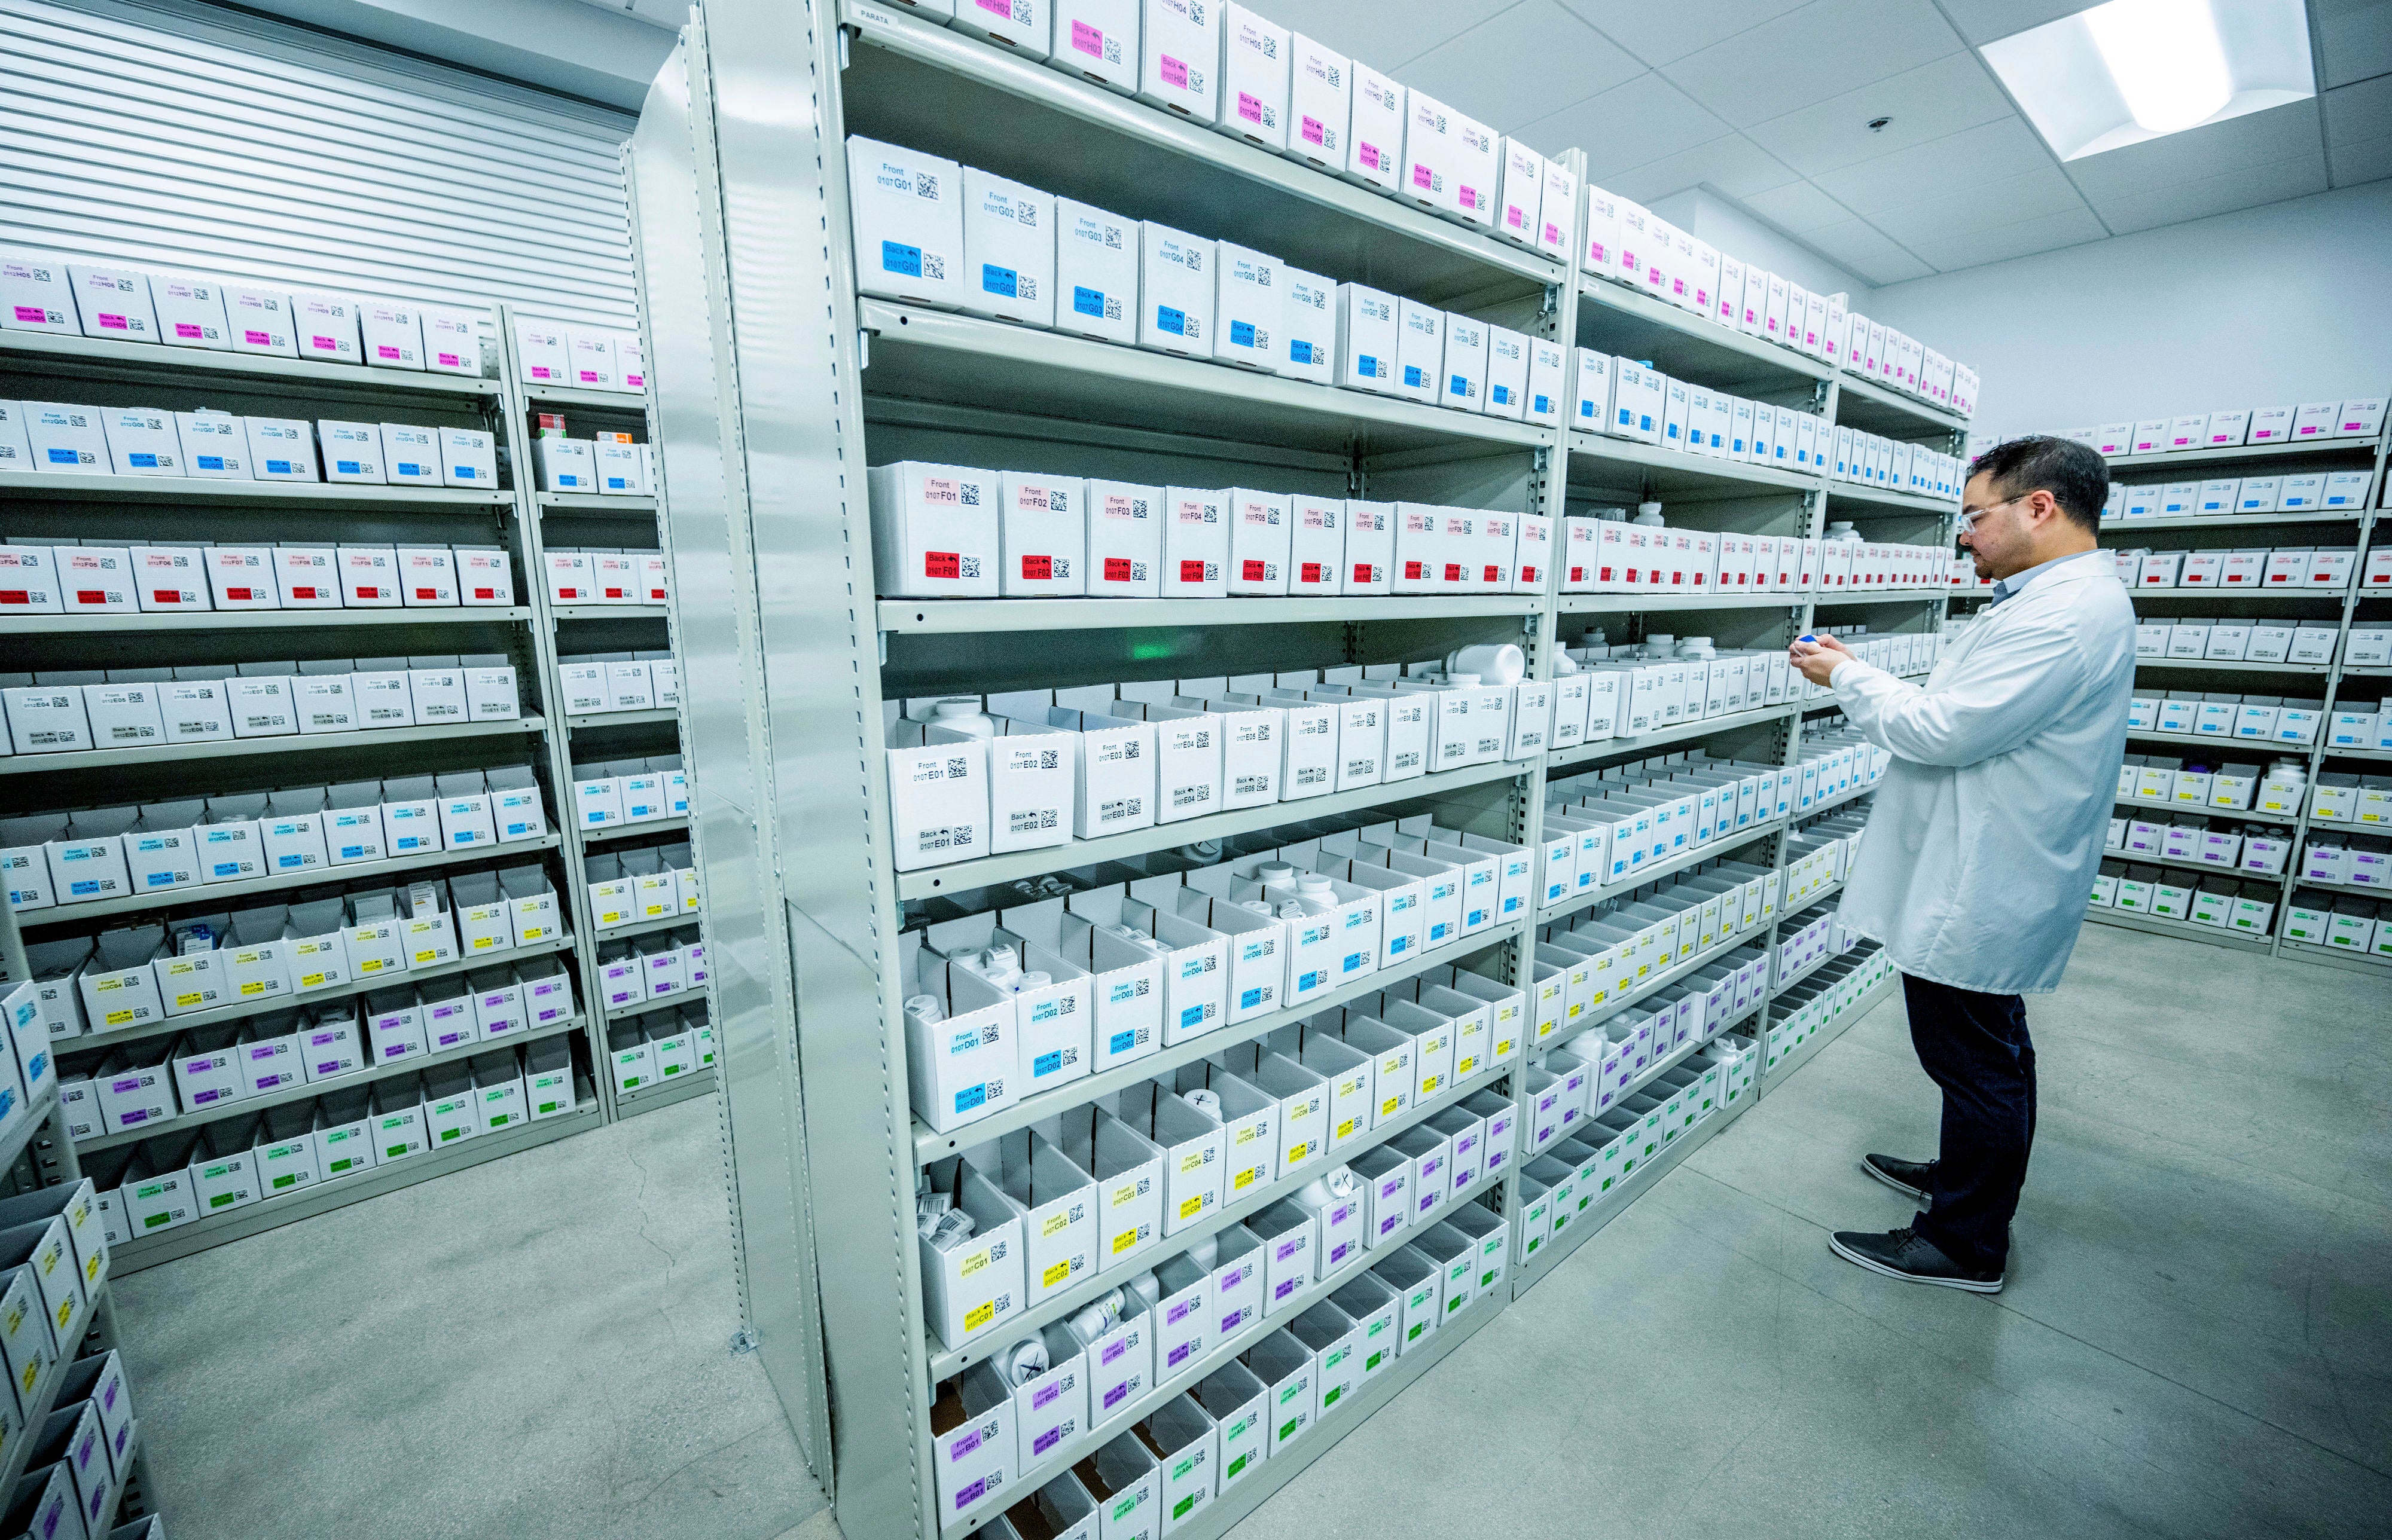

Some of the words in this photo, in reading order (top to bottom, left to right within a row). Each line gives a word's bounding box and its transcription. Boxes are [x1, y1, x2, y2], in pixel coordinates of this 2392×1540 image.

[861, 10, 889, 25] PARATA
[1074, 22, 1090, 36] Back
[1243, 25, 1256, 37] Front
[1163, 57, 1177, 68] Back
[1310, 55, 1322, 66] Front
[1240, 94, 1252, 105] Back
[1304, 117, 1314, 128] Back
[883, 163, 904, 176] Front
[989, 191, 1008, 204] Front
[1079, 218, 1096, 229] Front
[885, 243, 904, 255] Back
[1164, 240, 1179, 251] Front
[1237, 261, 1250, 270] Front
[985, 267, 1002, 277] Back
[1076, 286, 1091, 298] Back
[930, 479, 950, 489] Front
[1025, 487, 1041, 496] Front
[929, 554, 946, 562] Back
[920, 830, 937, 839] Back
[1185, 960, 1198, 968] Front
[1036, 1002, 1052, 1011] Front
[956, 1032, 972, 1041] Front
[1112, 1035, 1124, 1043] Back
[1036, 1056, 1049, 1065] Back
[957, 1091, 972, 1100] Back
[1185, 1154, 1197, 1162] Front
[1117, 1186, 1130, 1196] Front
[1046, 1214, 1061, 1226] Front
[1115, 1234, 1127, 1243] Back
[966, 1253, 981, 1265] Front
[1045, 1267, 1058, 1276] Back
[1225, 1272, 1237, 1282] Front
[966, 1309, 981, 1320] Back
[1106, 1343, 1119, 1353] Front
[1038, 1386, 1052, 1398] Front
[1105, 1389, 1117, 1400] Back
[956, 1435, 972, 1448] Front
[1035, 1435, 1048, 1446] Back
[1176, 1460, 1188, 1471] Front
[957, 1487, 972, 1499] Back
[1117, 1499, 1130, 1511] Front
